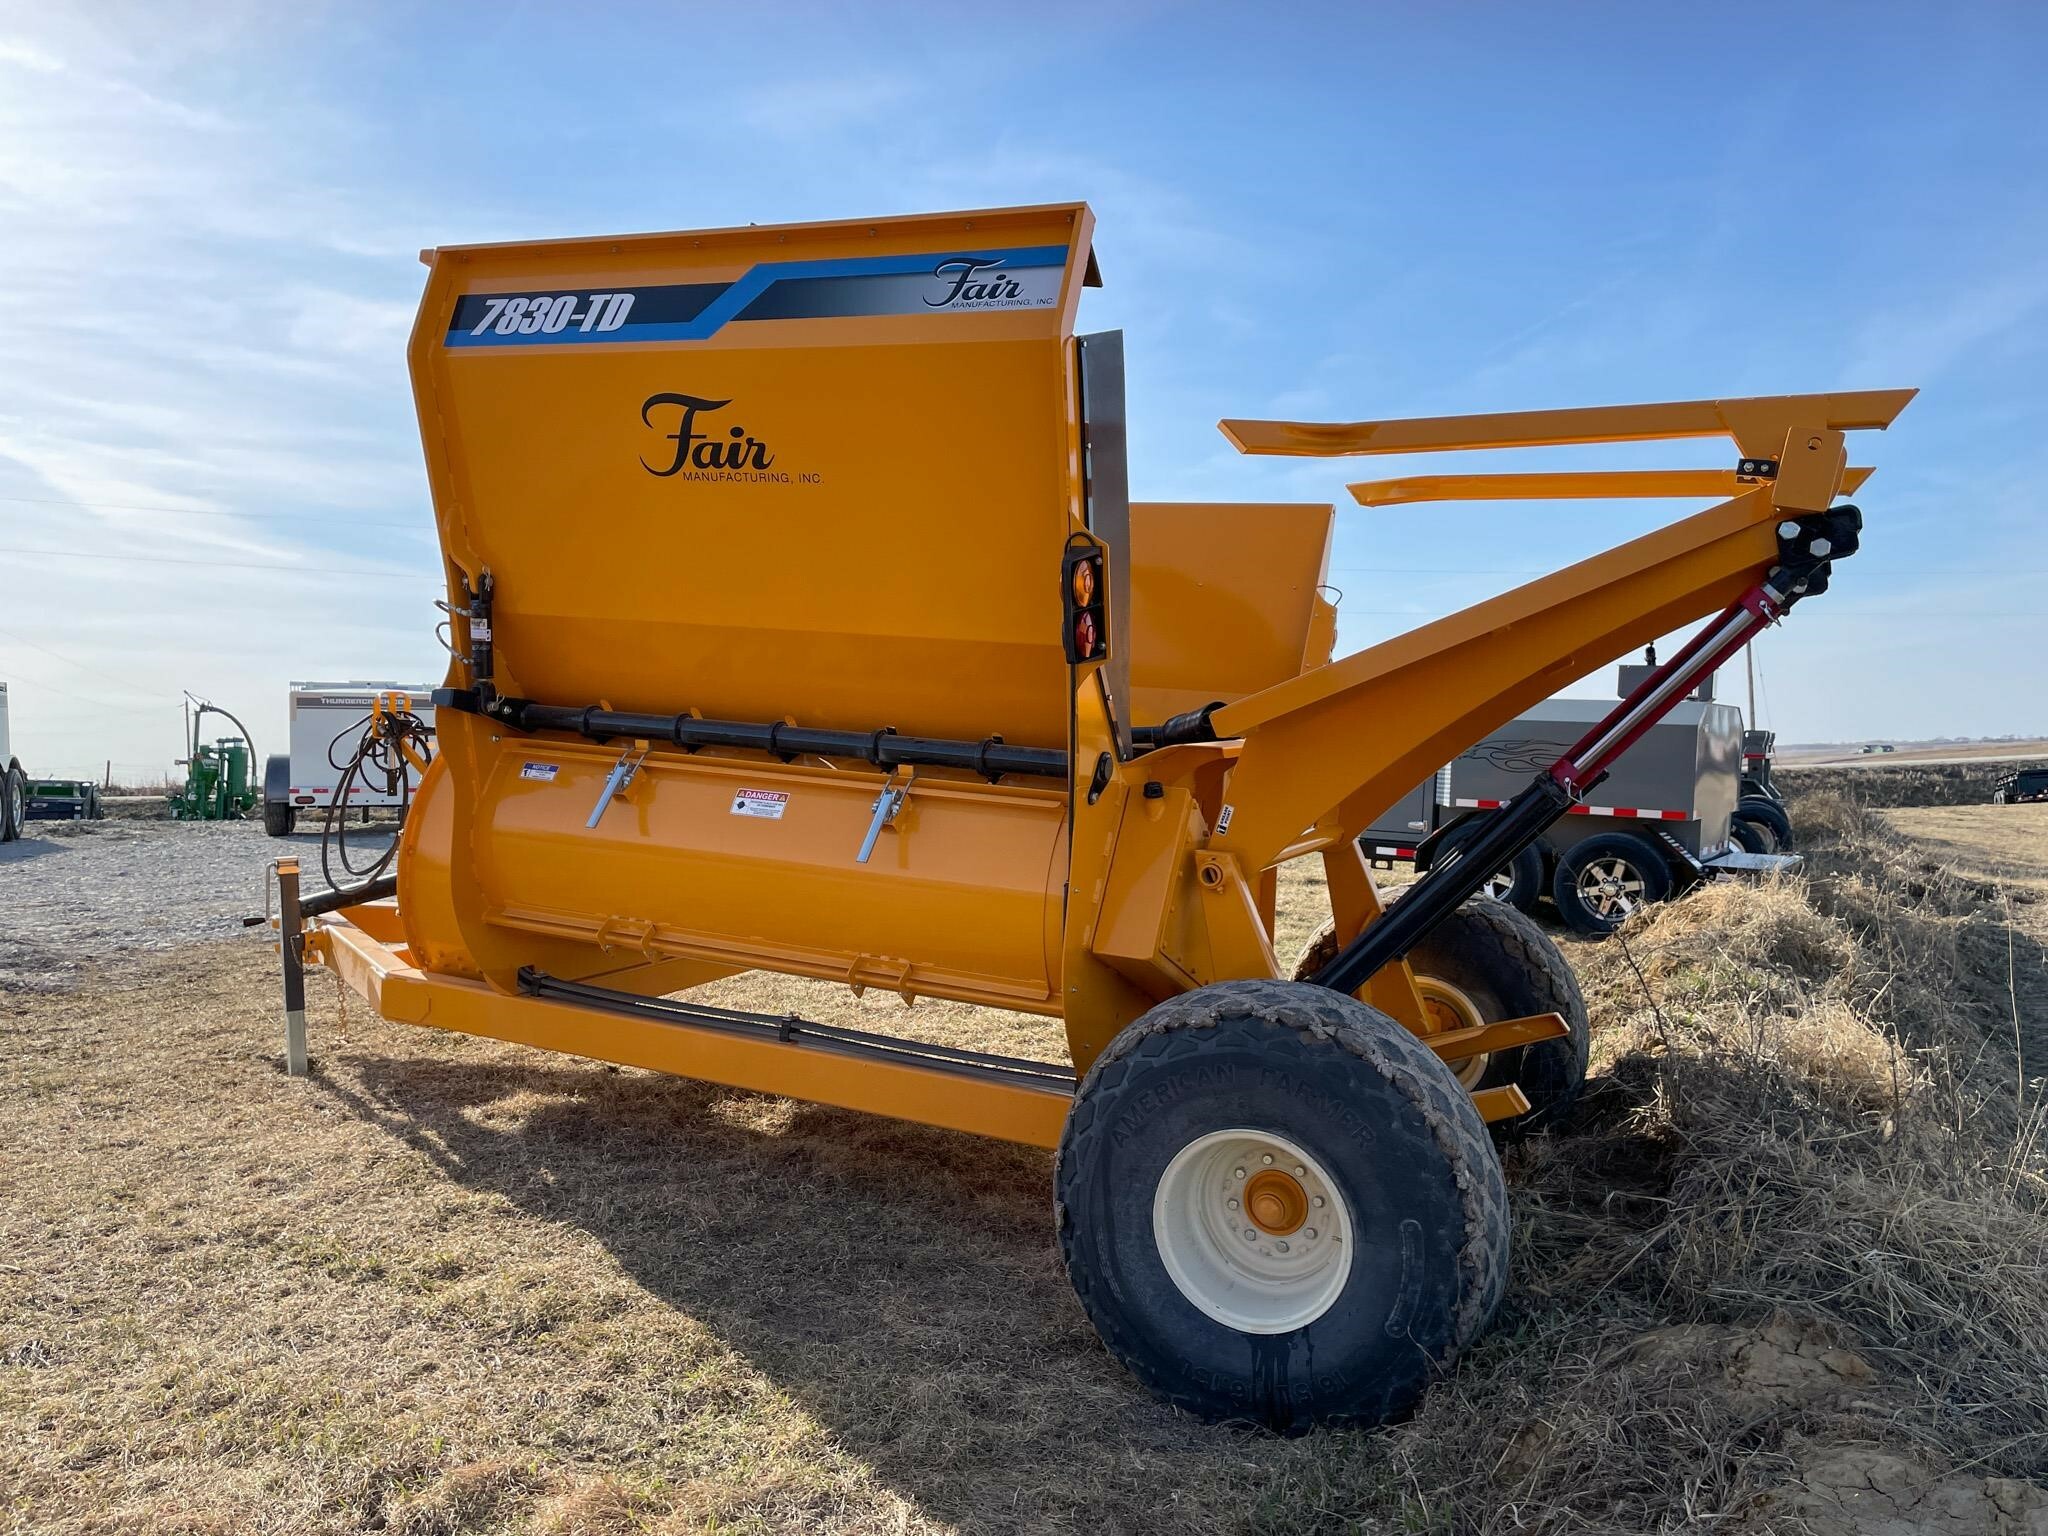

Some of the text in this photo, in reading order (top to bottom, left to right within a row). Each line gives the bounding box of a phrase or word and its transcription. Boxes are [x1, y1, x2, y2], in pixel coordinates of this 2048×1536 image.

[922, 257, 1025, 307] Fair
[951, 299, 1033, 309] MANUFACTURING,
[470, 292, 636, 336] 7830-TD
[639, 392, 776, 477] Fair
[683, 471, 825, 485] MANUFACTURING, INC.
[745, 791, 780, 801] DANGER
[1111, 1063, 1237, 1149] AMERICAN
